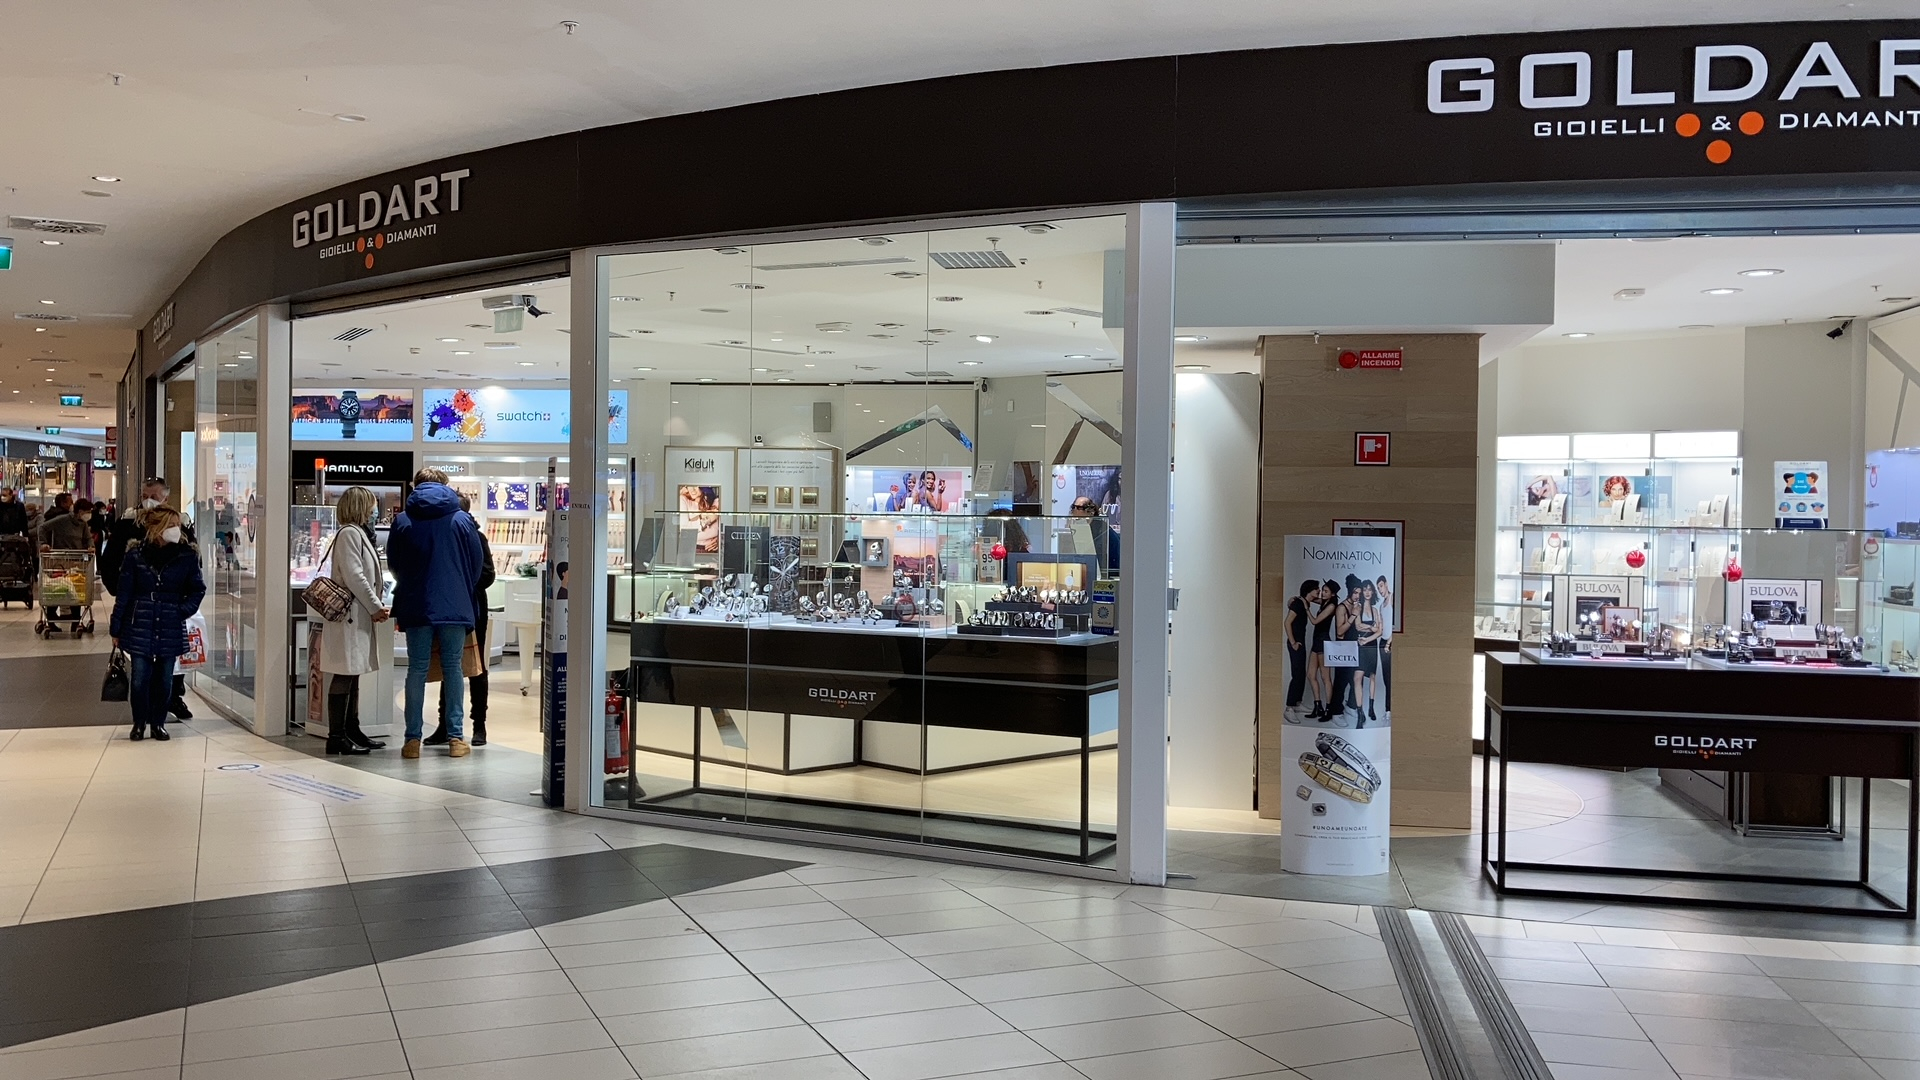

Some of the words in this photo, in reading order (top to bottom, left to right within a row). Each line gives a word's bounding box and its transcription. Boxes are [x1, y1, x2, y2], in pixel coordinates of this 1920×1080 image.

[1533, 117, 1665, 137] GIOIELLI
[1711, 115, 1732, 131] &
[292, 168, 470, 248] GOLDART
[319, 241, 355, 259] GIOIELLI
[386, 223, 437, 244] DIAMANTI
[496, 411, 542, 422] swatch
[684, 457, 715, 470] Kidult
[730, 531, 762, 541] CITIZEN
[1331, 562, 1357, 570] ITALY
[1575, 583, 1622, 594] BULOVA
[1749, 586, 1798, 597] BULOVA
[1327, 653, 1357, 662] USCITA
[808, 687, 877, 701] GOLDART
[1654, 735, 1757, 749] GOLDART
